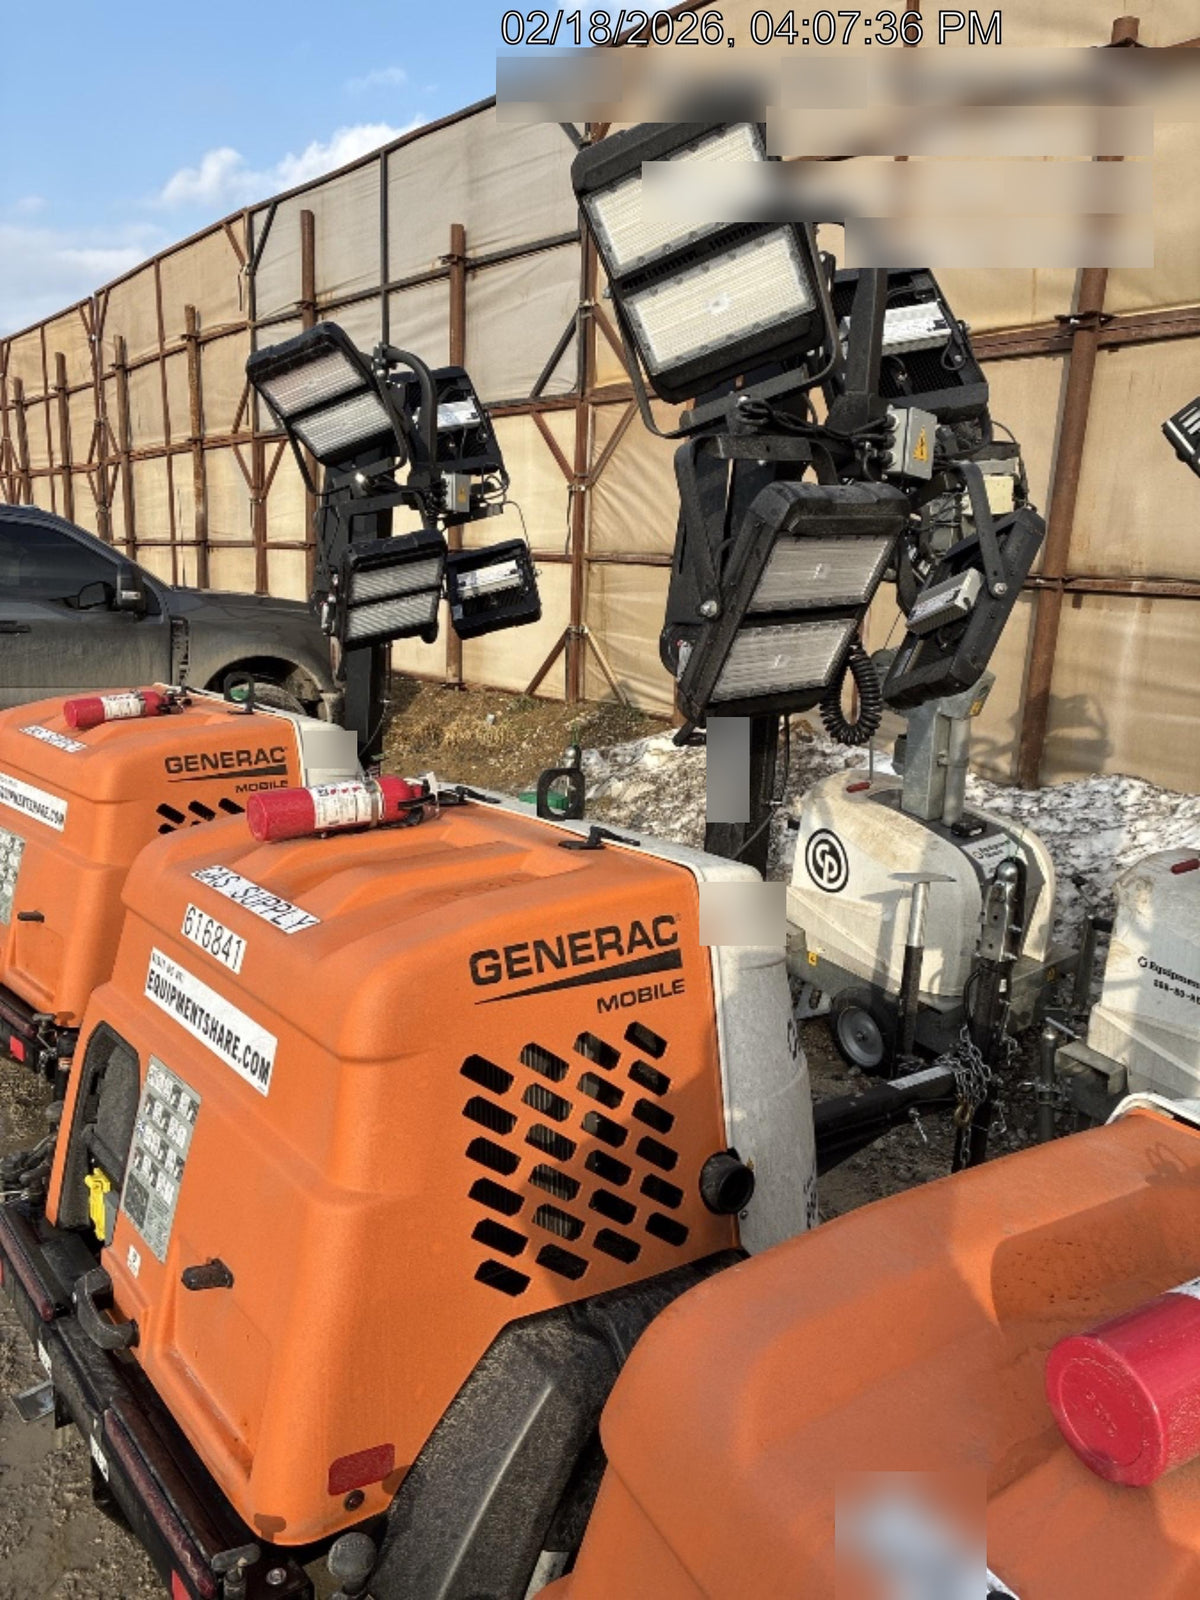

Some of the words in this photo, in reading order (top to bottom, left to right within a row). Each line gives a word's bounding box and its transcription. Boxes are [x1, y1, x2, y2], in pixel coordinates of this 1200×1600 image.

[164, 746, 286, 775] GENERAC
[235, 780, 289, 793] MOBILE
[184, 905, 243, 970] 616841
[468, 914, 679, 986] GENERAC
[596, 977, 686, 1014] MOBILE
[146, 968, 271, 1086] EQUIPMENTSHARE.COM
